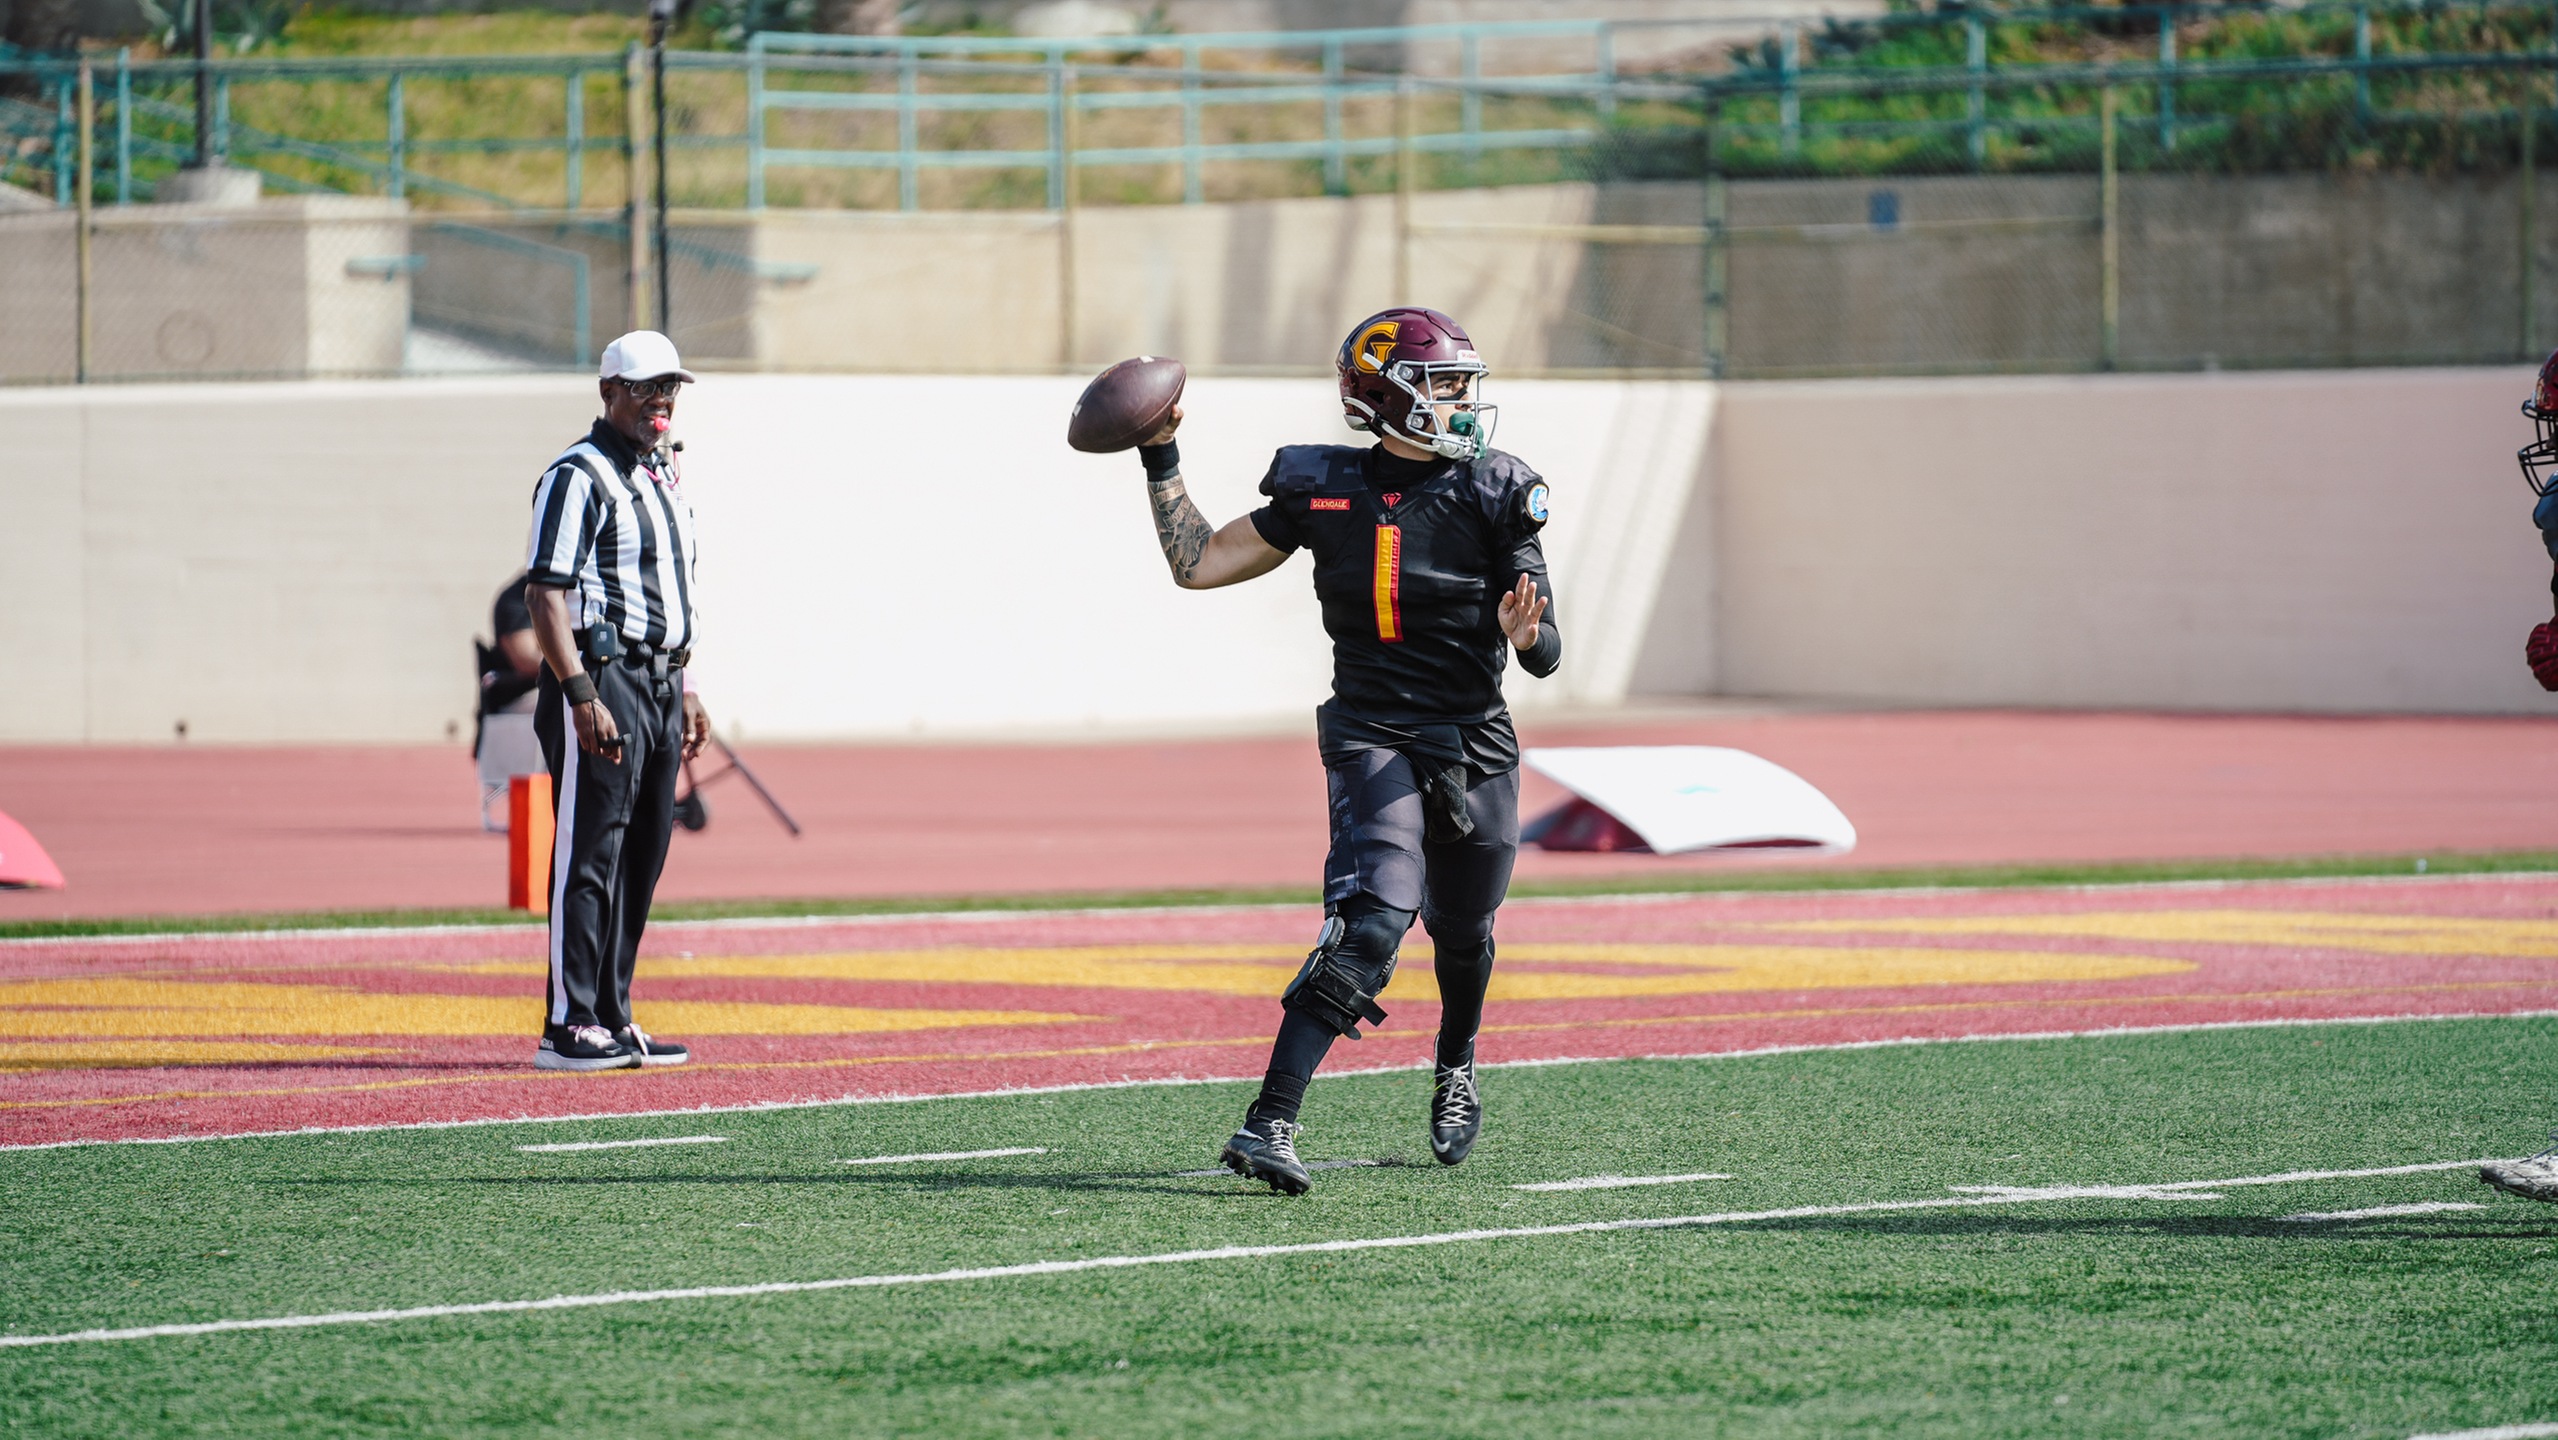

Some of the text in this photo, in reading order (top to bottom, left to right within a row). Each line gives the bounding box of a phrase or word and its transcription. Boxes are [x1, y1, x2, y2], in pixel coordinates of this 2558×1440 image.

[1350, 320, 1401, 374] G
[1312, 500, 1348, 509] GLENDALE
[1373, 523, 1404, 643] 1
